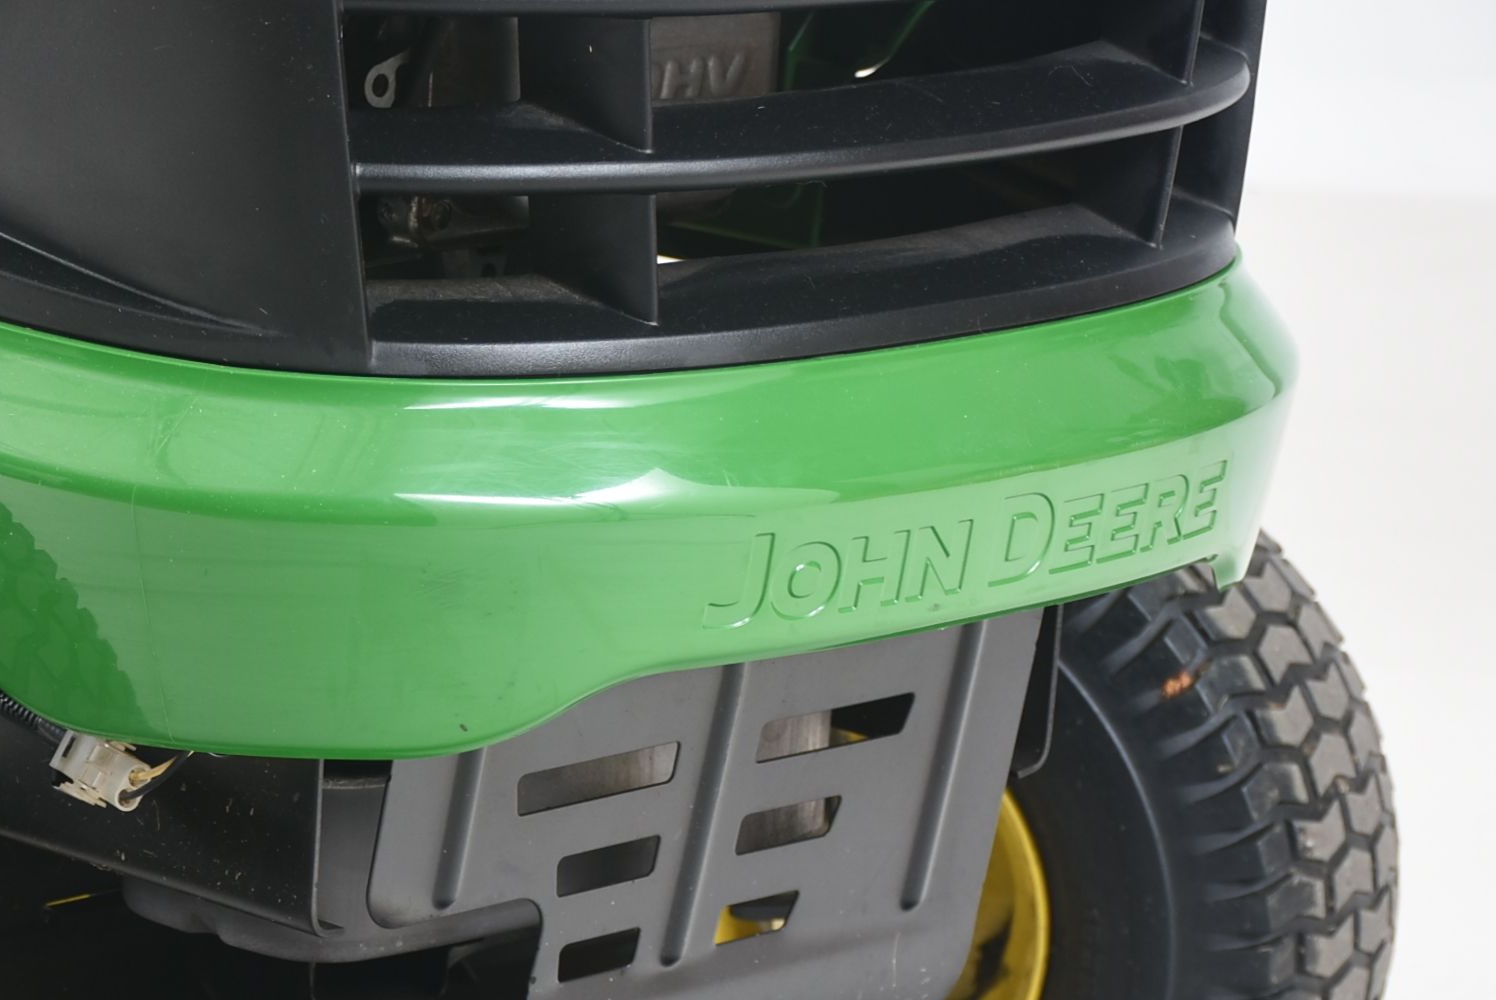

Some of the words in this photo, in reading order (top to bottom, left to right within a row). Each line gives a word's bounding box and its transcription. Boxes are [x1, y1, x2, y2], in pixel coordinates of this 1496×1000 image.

[651, 52, 746, 100] HV
[702, 518, 974, 630] JOHN
[988, 459, 1228, 588] DEERE
